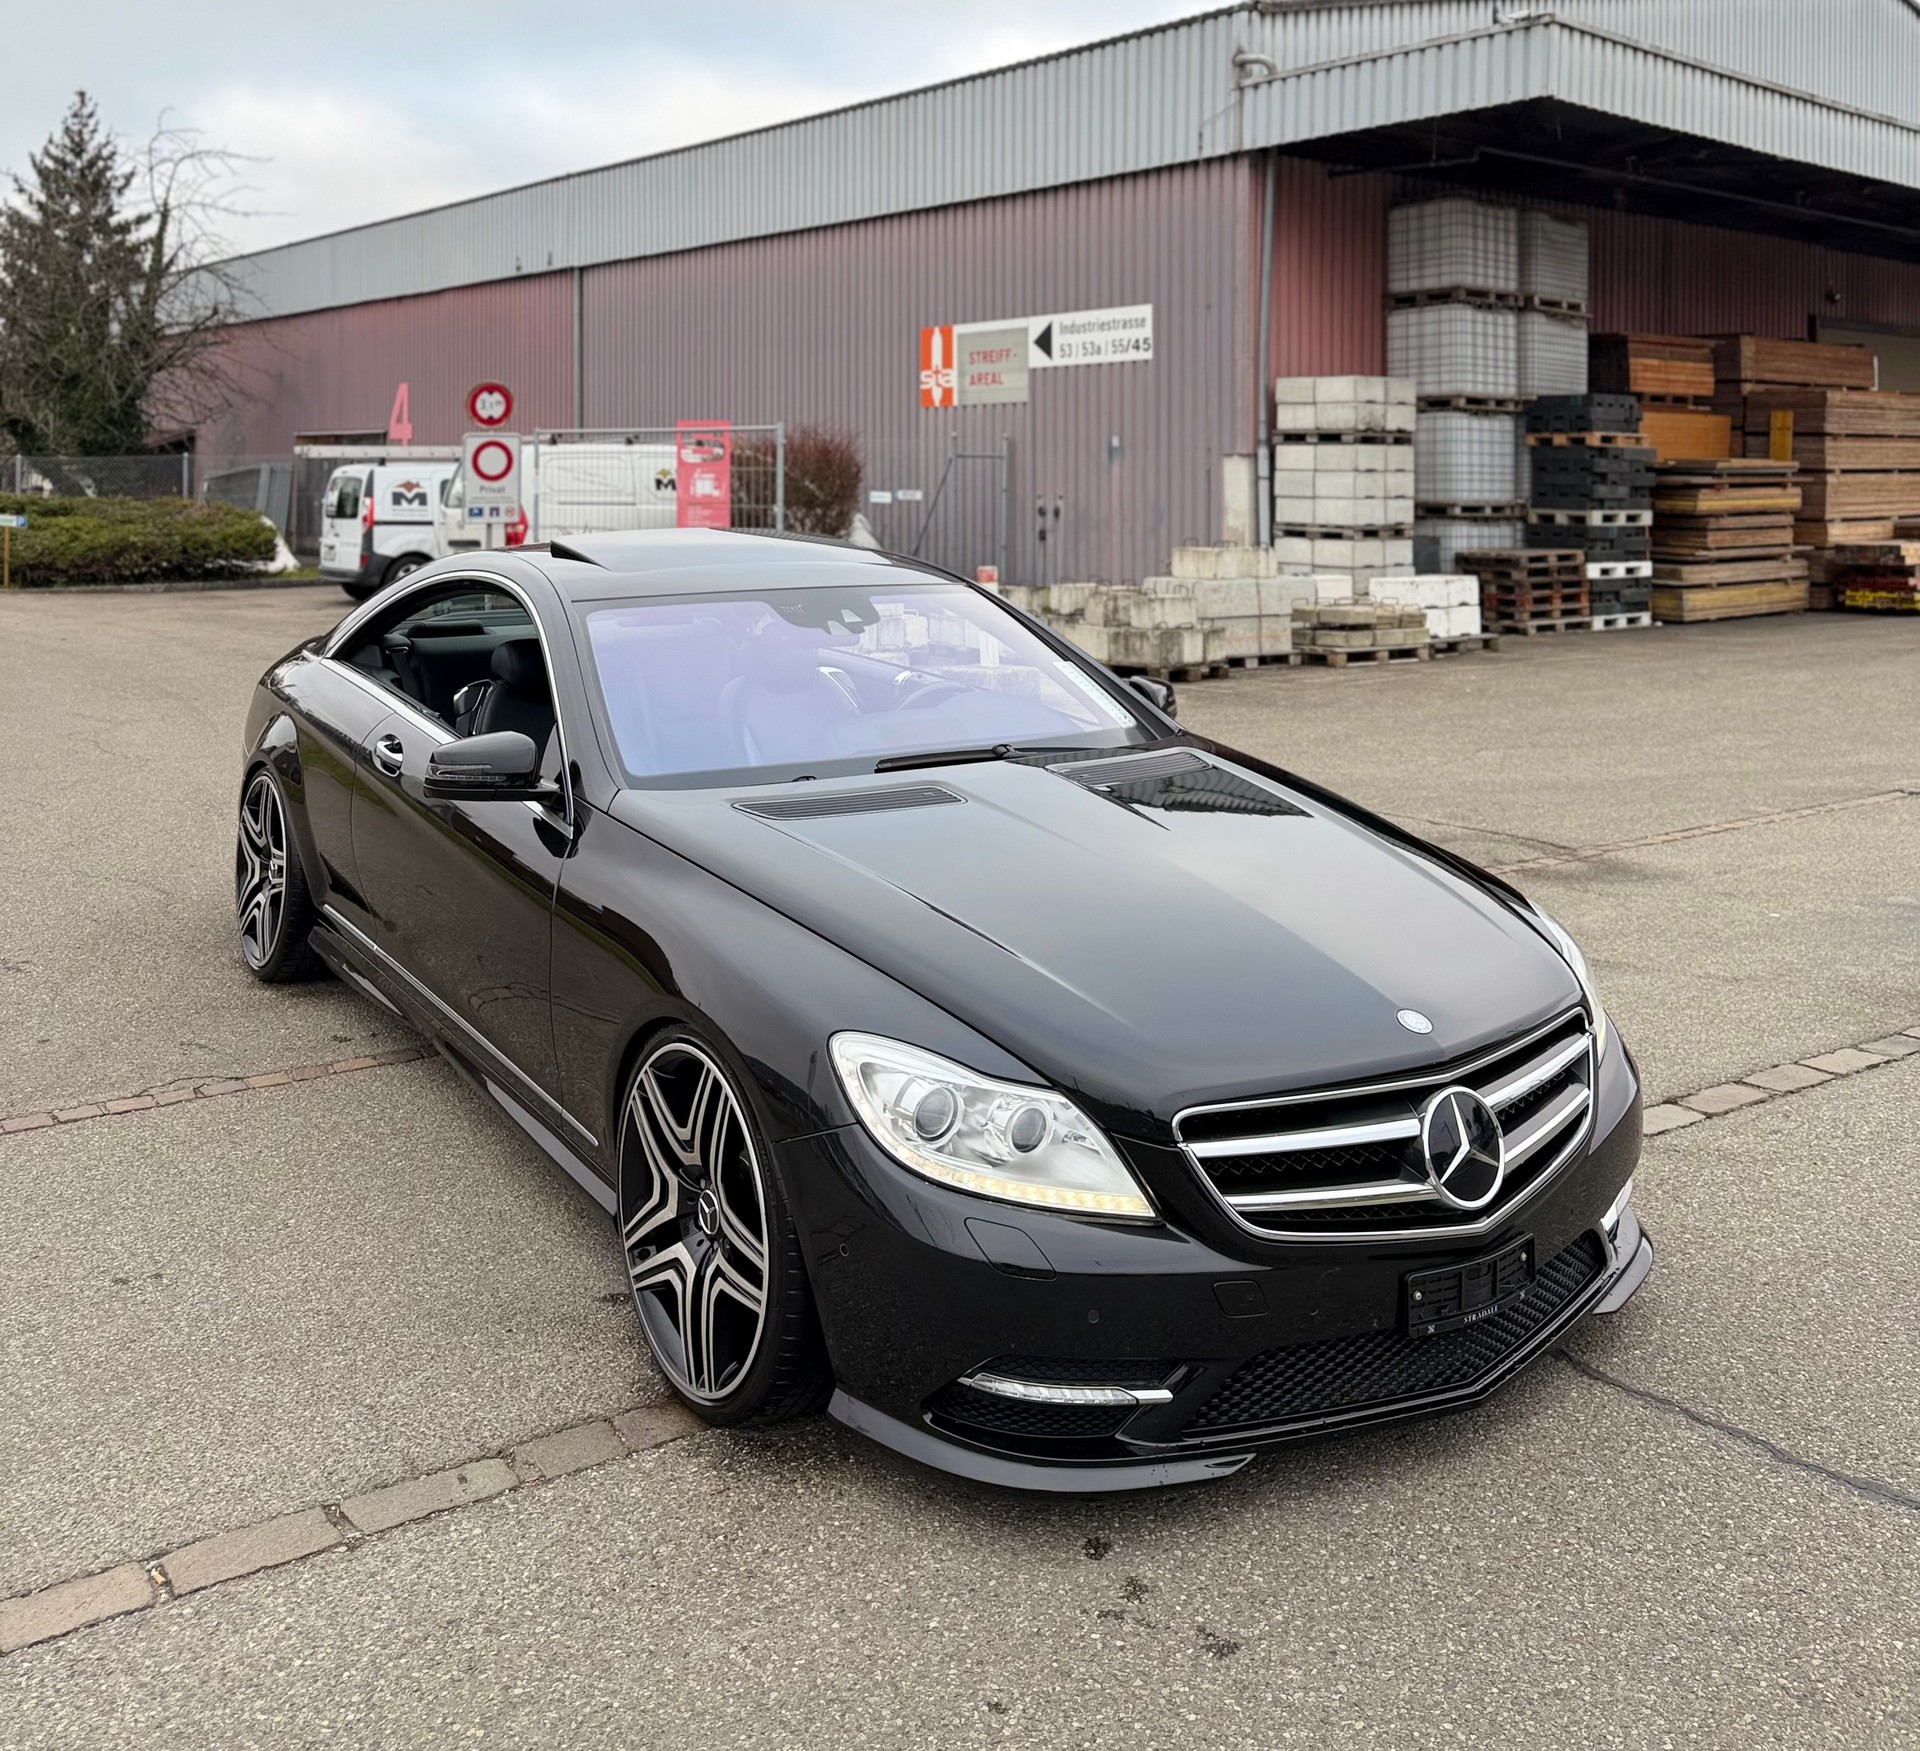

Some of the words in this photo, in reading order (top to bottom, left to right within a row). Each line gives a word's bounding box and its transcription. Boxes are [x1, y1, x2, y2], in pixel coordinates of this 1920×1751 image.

[1059, 316, 1147, 335] Industriestrasse
[968, 347, 1018, 365] STREIFF-
[1059, 343, 1073, 359] 53
[1081, 341, 1102, 357] 53a
[969, 371, 1004, 387] AREAL
[388, 382, 412, 447] 4
